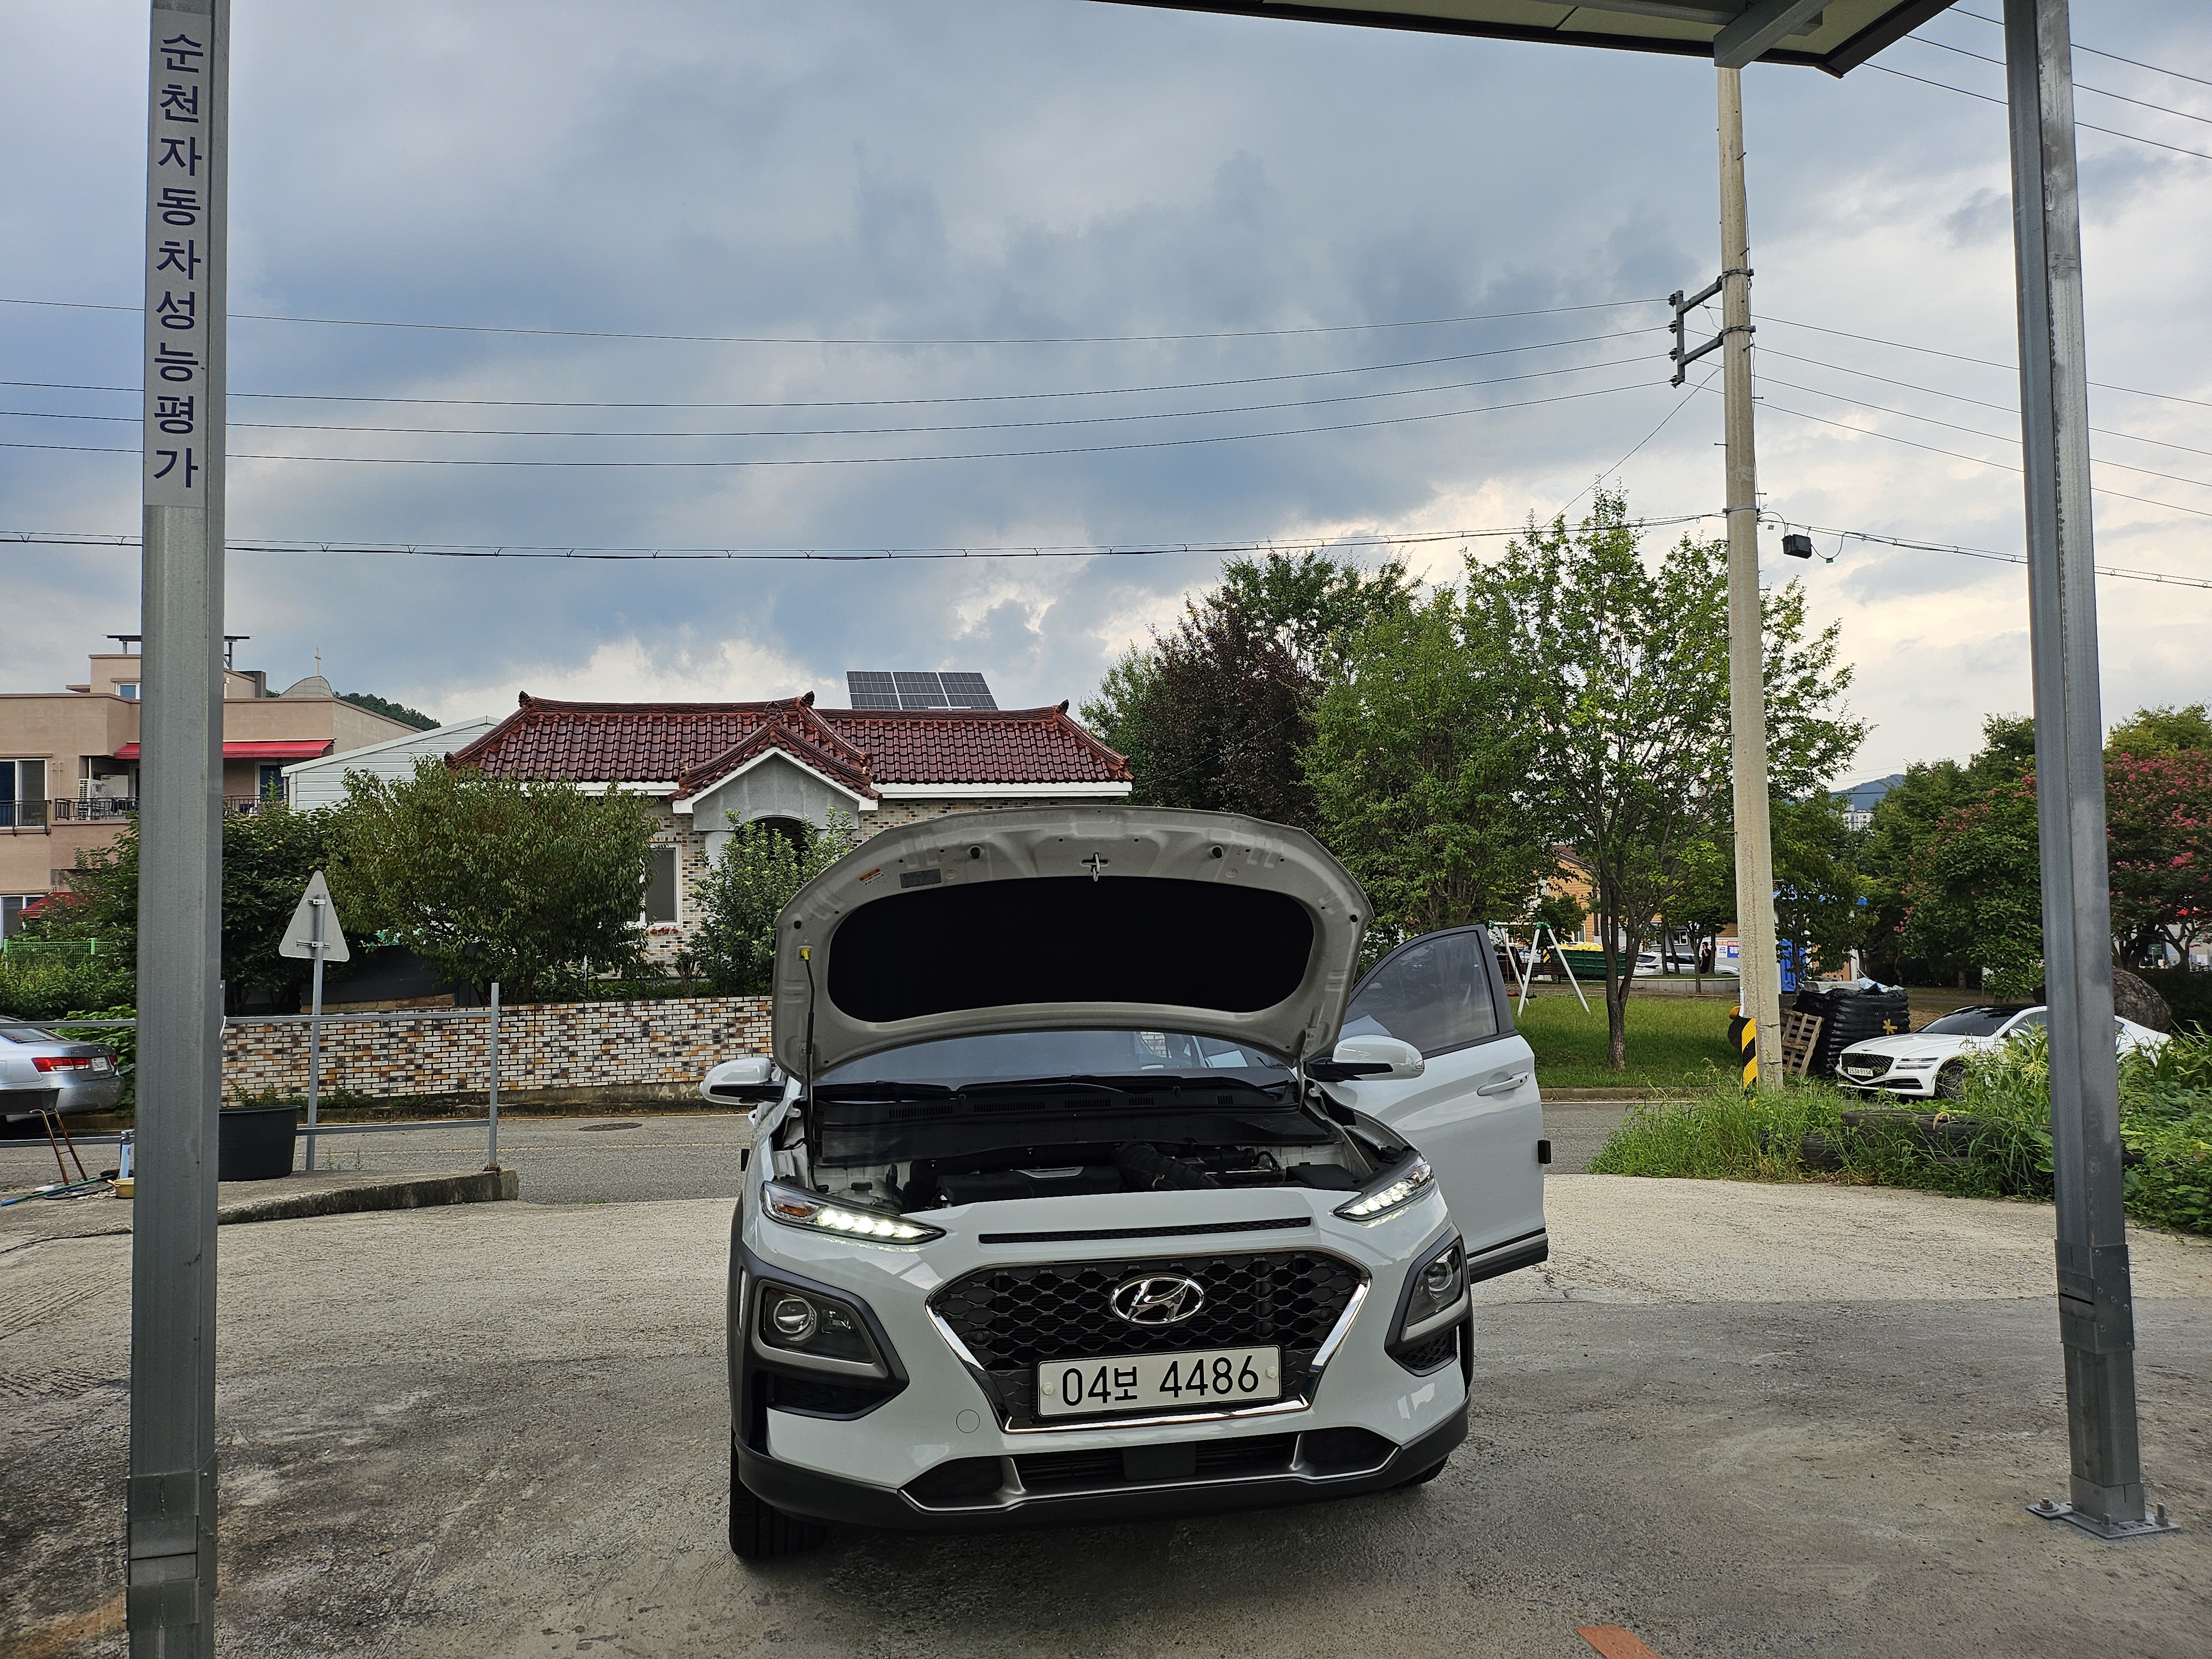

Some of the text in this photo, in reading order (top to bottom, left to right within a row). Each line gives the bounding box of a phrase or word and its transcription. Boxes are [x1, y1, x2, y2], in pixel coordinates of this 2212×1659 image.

[153, 33, 204, 488] 순천자동차성능평가
[1062, 1355, 1259, 1406] 04보 4486
